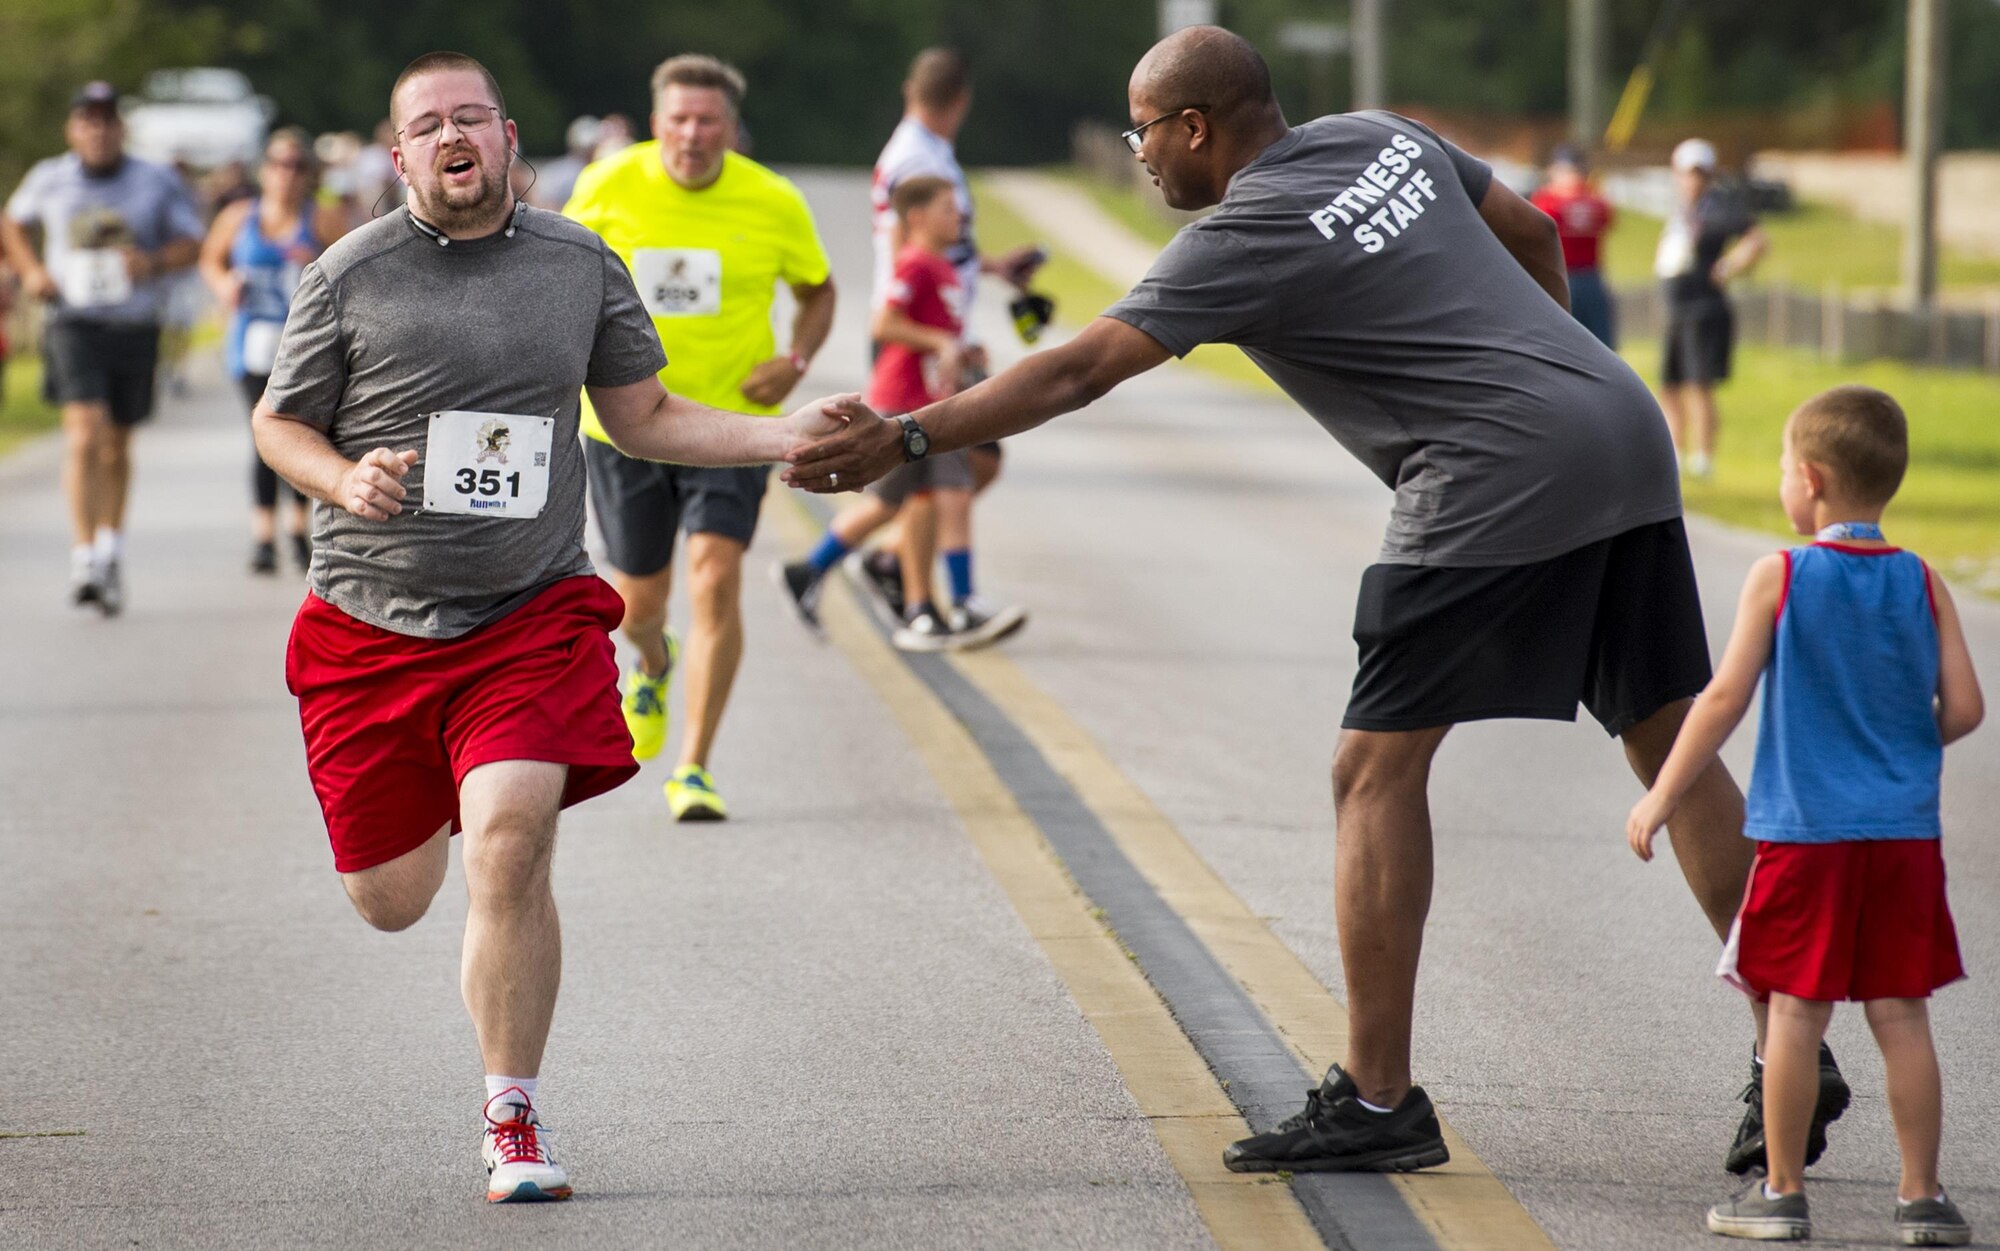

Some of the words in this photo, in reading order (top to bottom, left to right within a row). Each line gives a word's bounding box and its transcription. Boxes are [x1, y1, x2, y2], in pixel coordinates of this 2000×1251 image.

[1308, 134, 1423, 240] FITNESS
[1353, 168, 1437, 253] STAFF
[454, 467, 520, 498] 351
